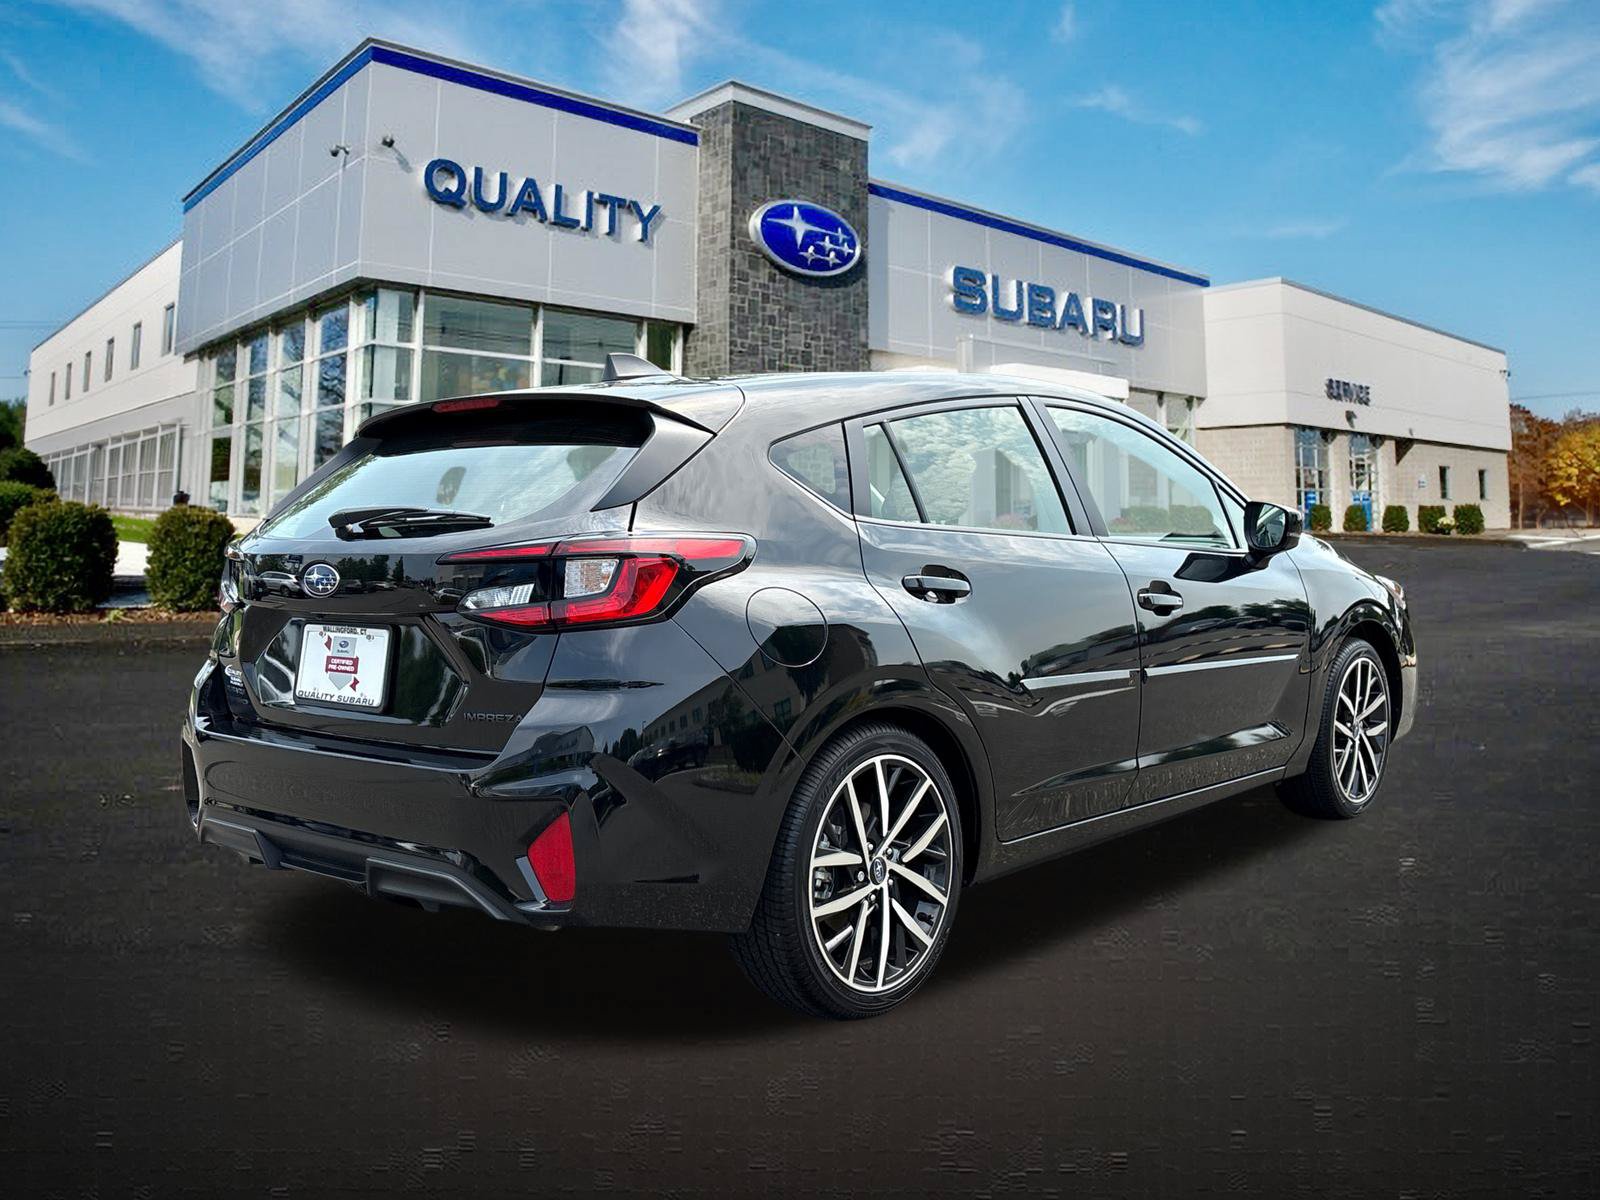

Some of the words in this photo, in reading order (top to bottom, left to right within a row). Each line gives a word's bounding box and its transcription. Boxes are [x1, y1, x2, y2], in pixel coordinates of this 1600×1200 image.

[423, 158, 661, 243] QUALITY
[949, 265, 1145, 346] SUBARU
[1325, 378, 1371, 406] SERVICE
[328, 664, 355, 672] PRE-OWNED
[297, 690, 334, 699] QUALITY
[336, 695, 374, 705] SUBARU
[463, 712, 523, 722] IMPREZA
